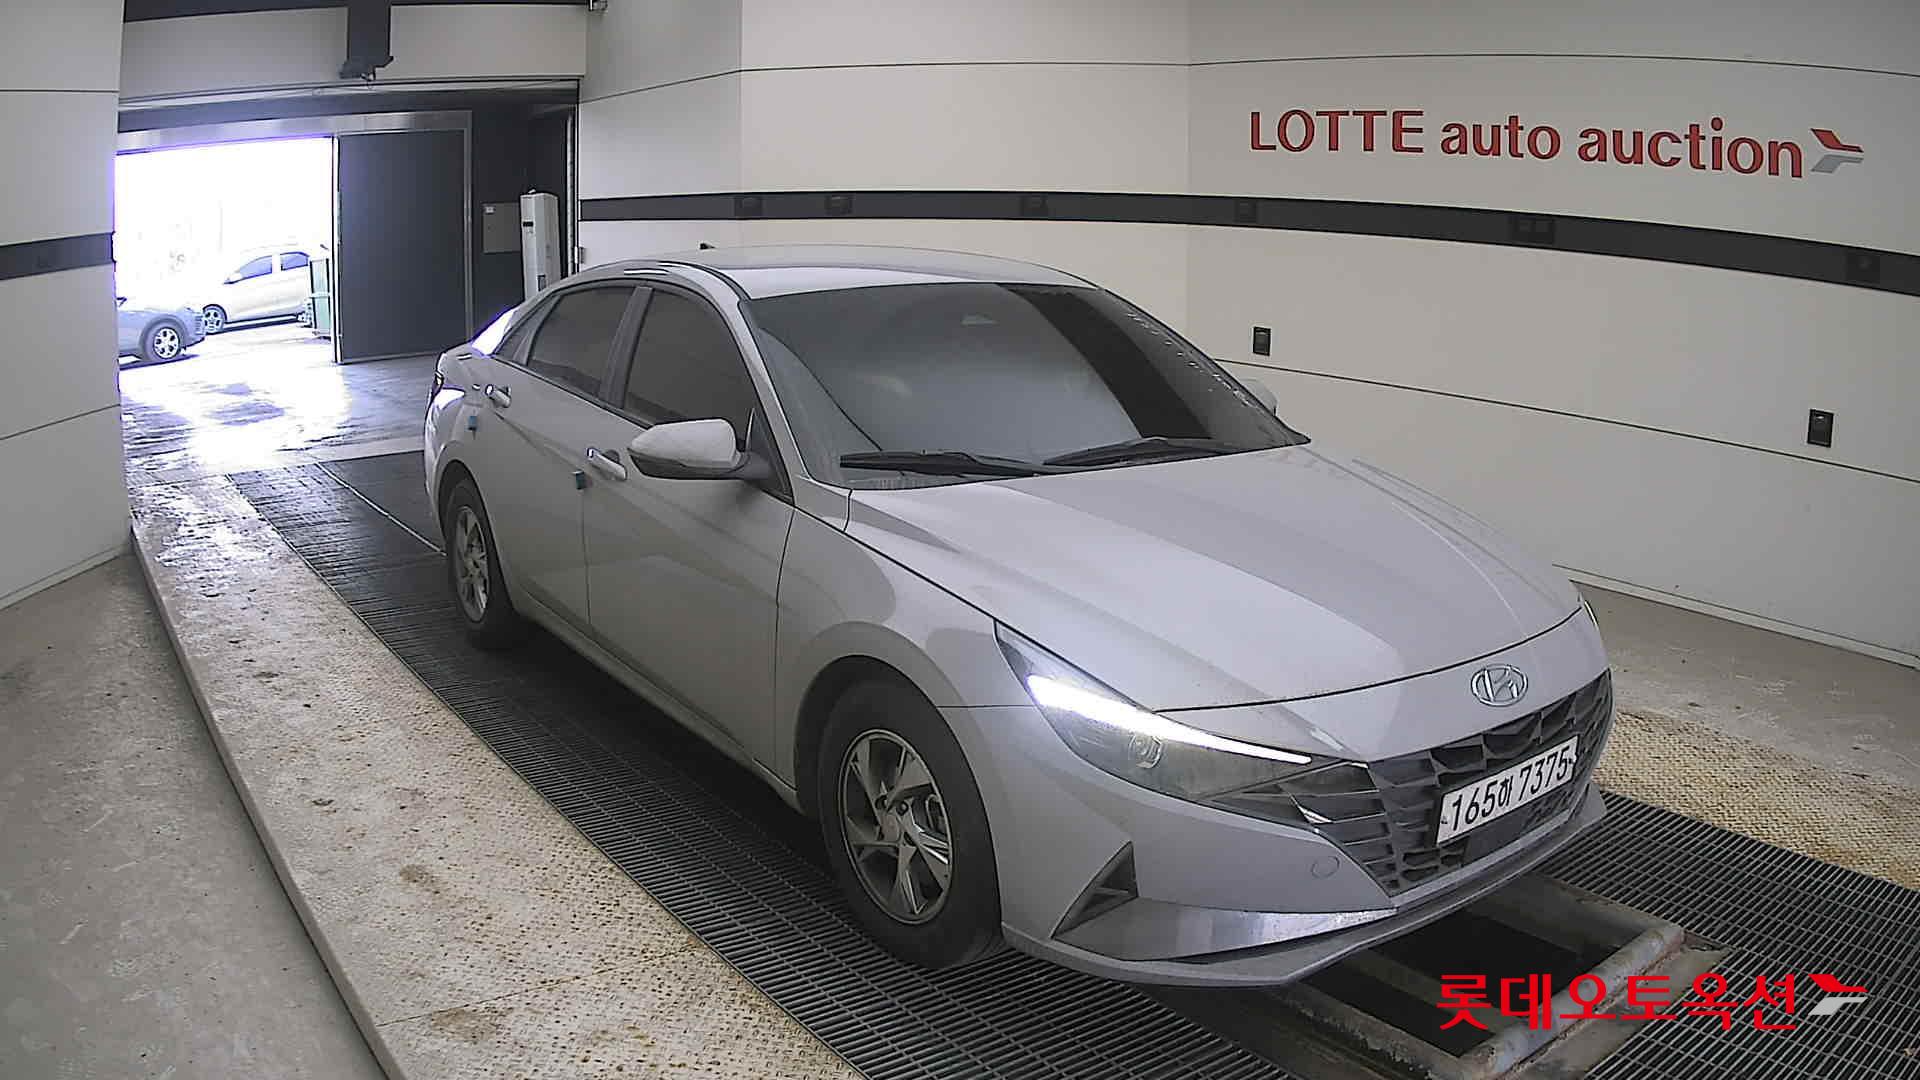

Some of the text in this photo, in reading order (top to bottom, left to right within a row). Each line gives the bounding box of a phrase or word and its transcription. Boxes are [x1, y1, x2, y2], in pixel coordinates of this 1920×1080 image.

[1249, 109, 1803, 179] LOTTE auto auction
[1518, 745, 1571, 802] 7375
